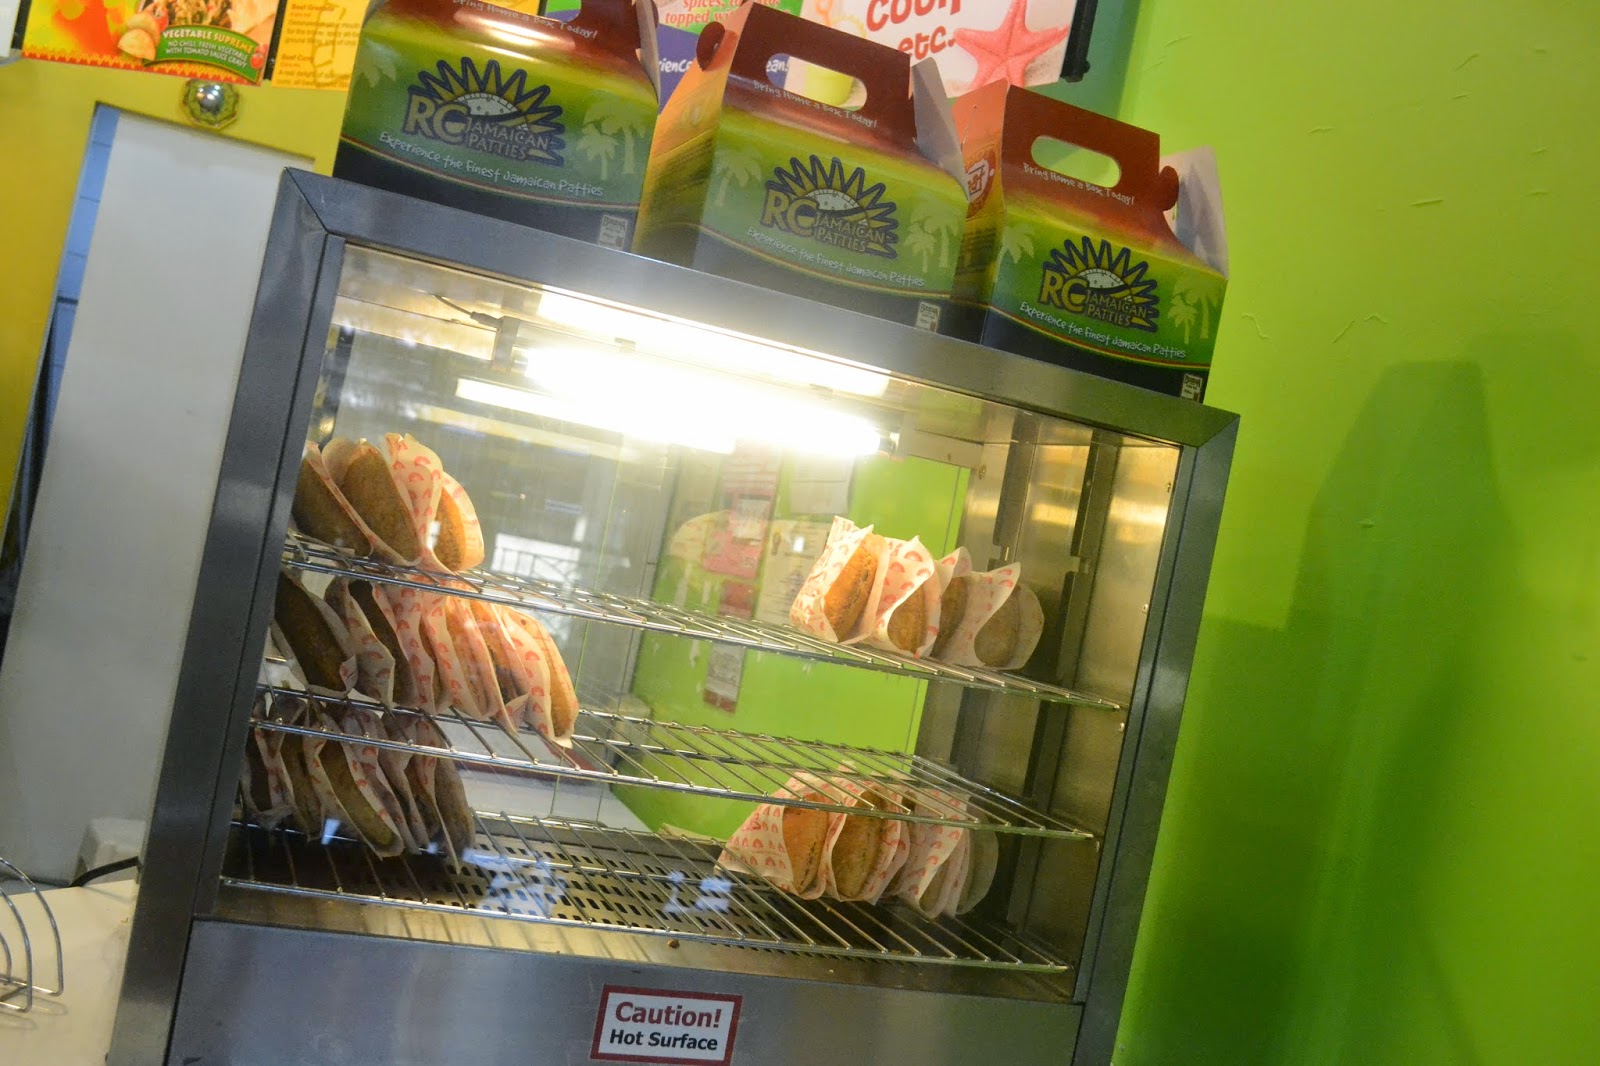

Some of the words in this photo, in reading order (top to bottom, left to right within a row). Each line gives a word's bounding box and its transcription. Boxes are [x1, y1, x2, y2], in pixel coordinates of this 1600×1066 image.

[486, 5, 519, 19] Home
[533, 16, 555, 29] Box
[557, 21, 598, 39] Today!
[665, 10, 710, 27] topped
[162, 29, 213, 39] VEGETABLE
[214, 33, 254, 54] SUPREME
[184, 47, 210, 56] TOMATO
[898, 26, 956, 60] etc.
[659, 57, 694, 73] ienc
[753, 80, 781, 97] Bring
[783, 91, 811, 106] Home
[823, 105, 843, 118] Box
[844, 110, 878, 128] Today!
[465, 116, 549, 150] JAMAICAN
[469, 133, 528, 160] PATTIES
[379, 131, 441, 162] Experience
[444, 154, 464, 169] the
[503, 170, 556, 191] Jamaican
[558, 179, 604, 197] Patties
[1023, 162, 1049, 181] Bring
[1050, 172, 1076, 187] Home
[1085, 182, 1104, 197] Box
[1104, 188, 1135, 206] Today!
[814, 211, 886, 244] JAMAICAN
[818, 228, 866, 253] PATTIES
[747, 226, 798, 255] Experience
[800, 248, 815, 262] the
[846, 263, 887, 280] Jamaican
[889, 271, 925, 288] Patties
[1085, 289, 1147, 319] JAMAICAN
[1087, 303, 1131, 327] PATTIES
[1020, 301, 1067, 329] Experience
[1067, 322, 1083, 335] the
[1112, 336, 1151, 353] Jamaican
[1153, 343, 1187, 359] Patties
[615, 1001, 722, 1029] Caution!
[609, 1029, 644, 1046] Hot
[648, 1031, 718, 1051] Surface
